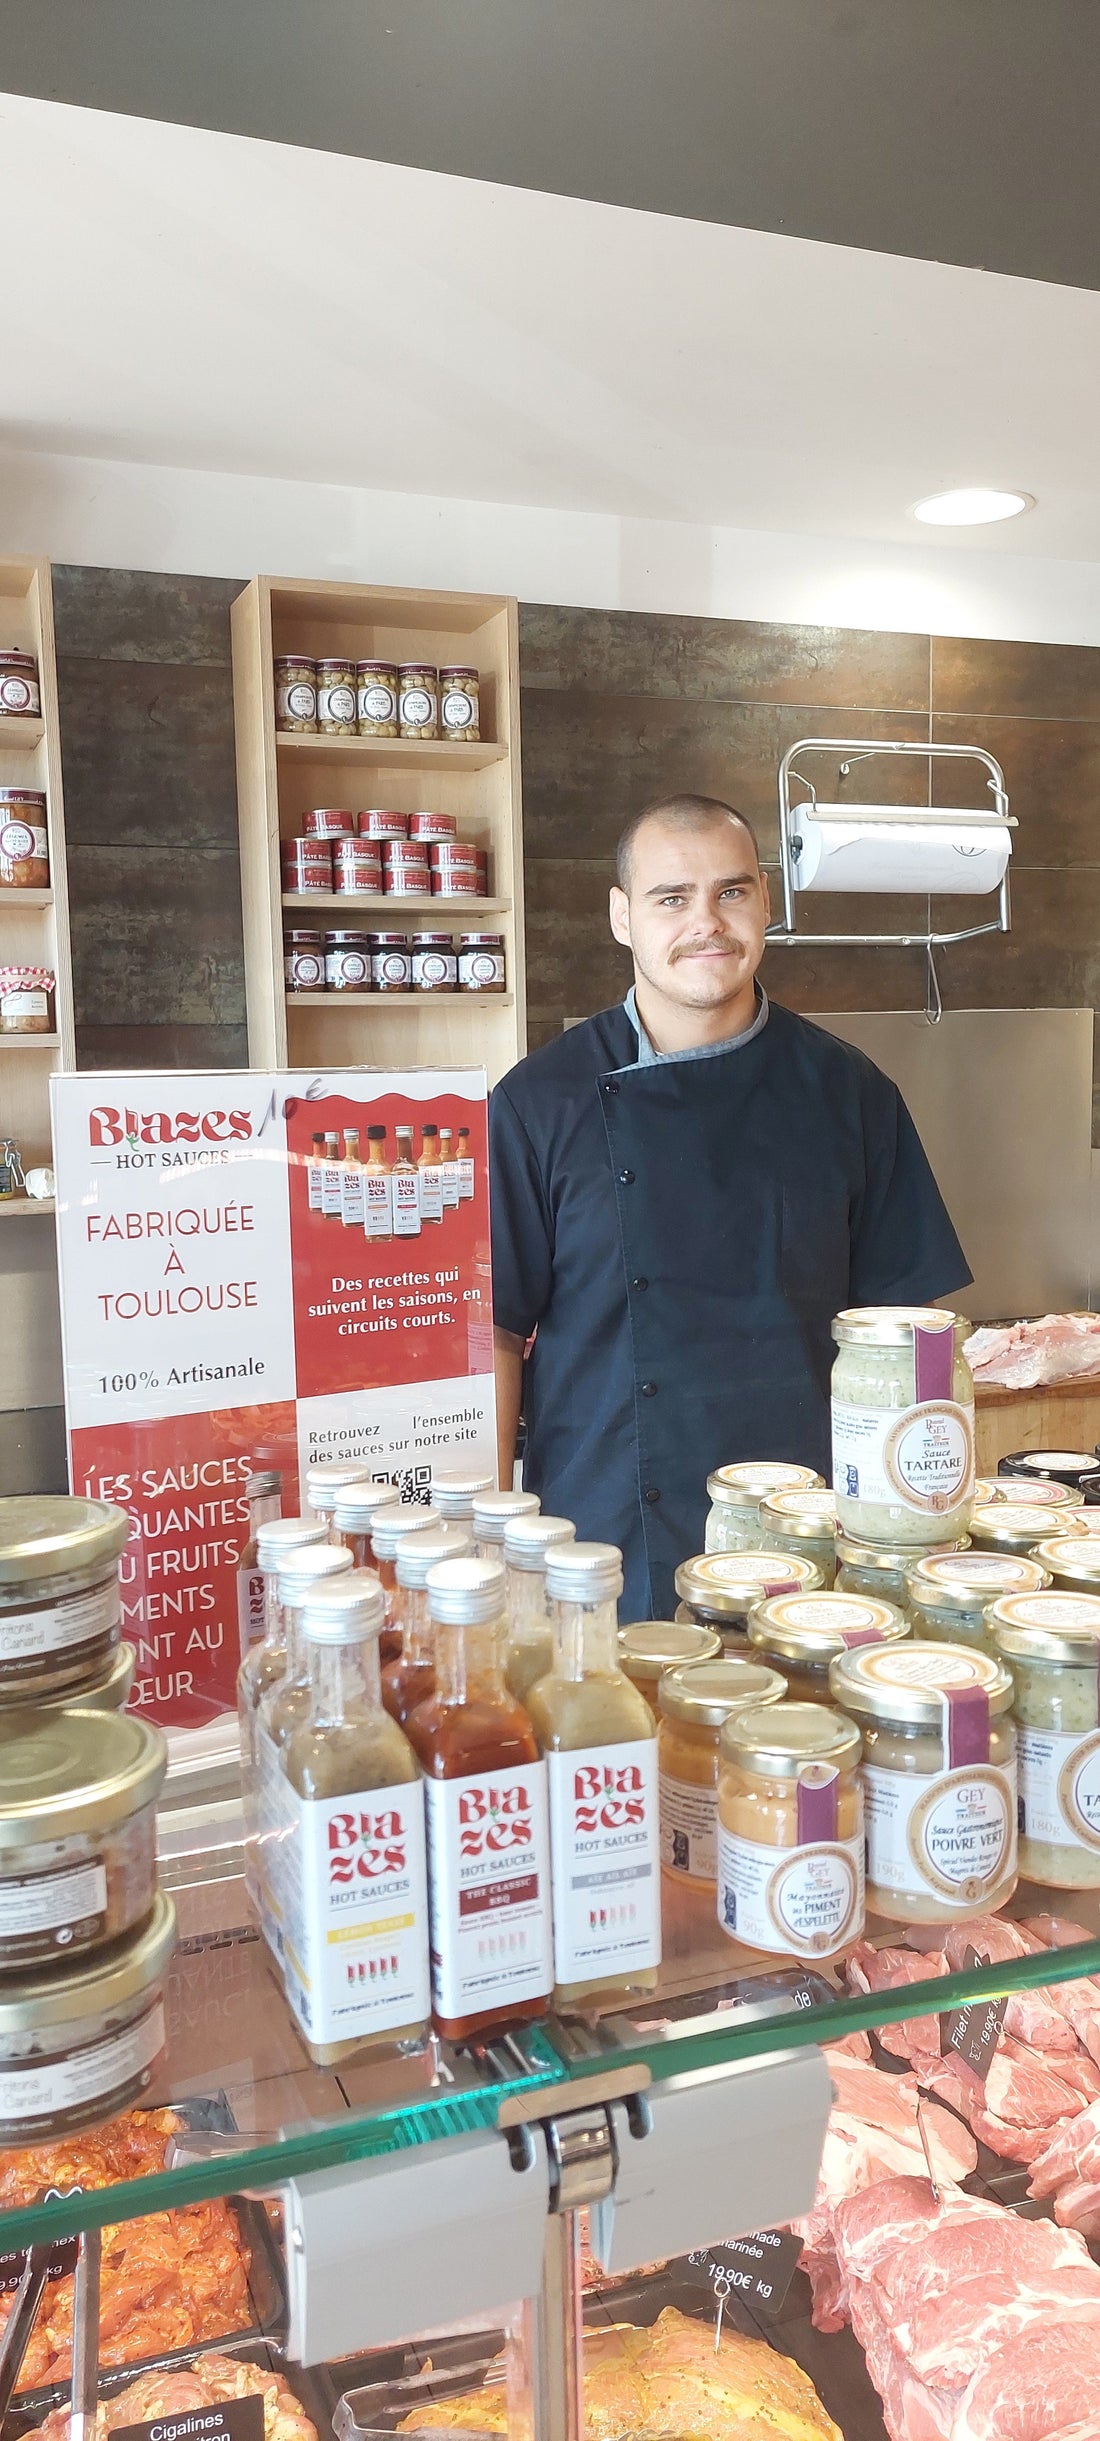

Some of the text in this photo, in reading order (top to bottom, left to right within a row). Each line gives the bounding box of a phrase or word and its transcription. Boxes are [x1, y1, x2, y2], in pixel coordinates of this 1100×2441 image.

[89, 1106, 253, 1148] Blazes
[116, 1150, 230, 1169] HOT SAUCES
[87, 1199, 254, 1242] FABRIQUÉE
[164, 1243, 185, 1275] À
[331, 1266, 459, 1293] Des recettes qui
[97, 1281, 258, 1321] TOULOUSE
[308, 1288, 481, 1317] suivent les saisons, en
[338, 1311, 456, 1336] circuits courts.
[98, 1357, 265, 1394] 100% Artisanale
[309, 1407, 484, 1444] Retrouvez l'ensemble
[309, 1427, 478, 1464] des sauces sur notre site
[922, 1449, 951, 1459] Sauce
[142, 1455, 253, 1498] SAUCES
[904, 1457, 962, 1471] TARTARE
[126, 1496, 251, 1542] QUANTES
[147, 1539, 240, 1579] FRUITS
[120, 1583, 216, 1625] MENTS
[185, 1623, 224, 1654] AU
[125, 1670, 193, 1708] ŒUR
[957, 1787, 985, 1803] GEY
[575, 1797, 645, 1834] zes
[931, 1825, 954, 1835] Sauce
[1031, 1818, 1060, 1836] 180g
[460, 1817, 532, 1859] zes
[575, 1831, 648, 1853] HOT SAUCES
[932, 1829, 1003, 1851] POIVRE VERT
[329, 1843, 406, 1885] zes
[460, 1852, 536, 1879] HOT SAUCES
[875, 1862, 904, 1882] 190g
[329, 1879, 410, 1905] HOT SAUCES
[466, 1877, 531, 1900] THE CLASSIC
[805, 1898, 841, 1914] PIMENT
[951, 2014, 969, 2050] Filet
[756, 2279, 773, 2298] kg
[150, 2413, 224, 2441] Cigalines
